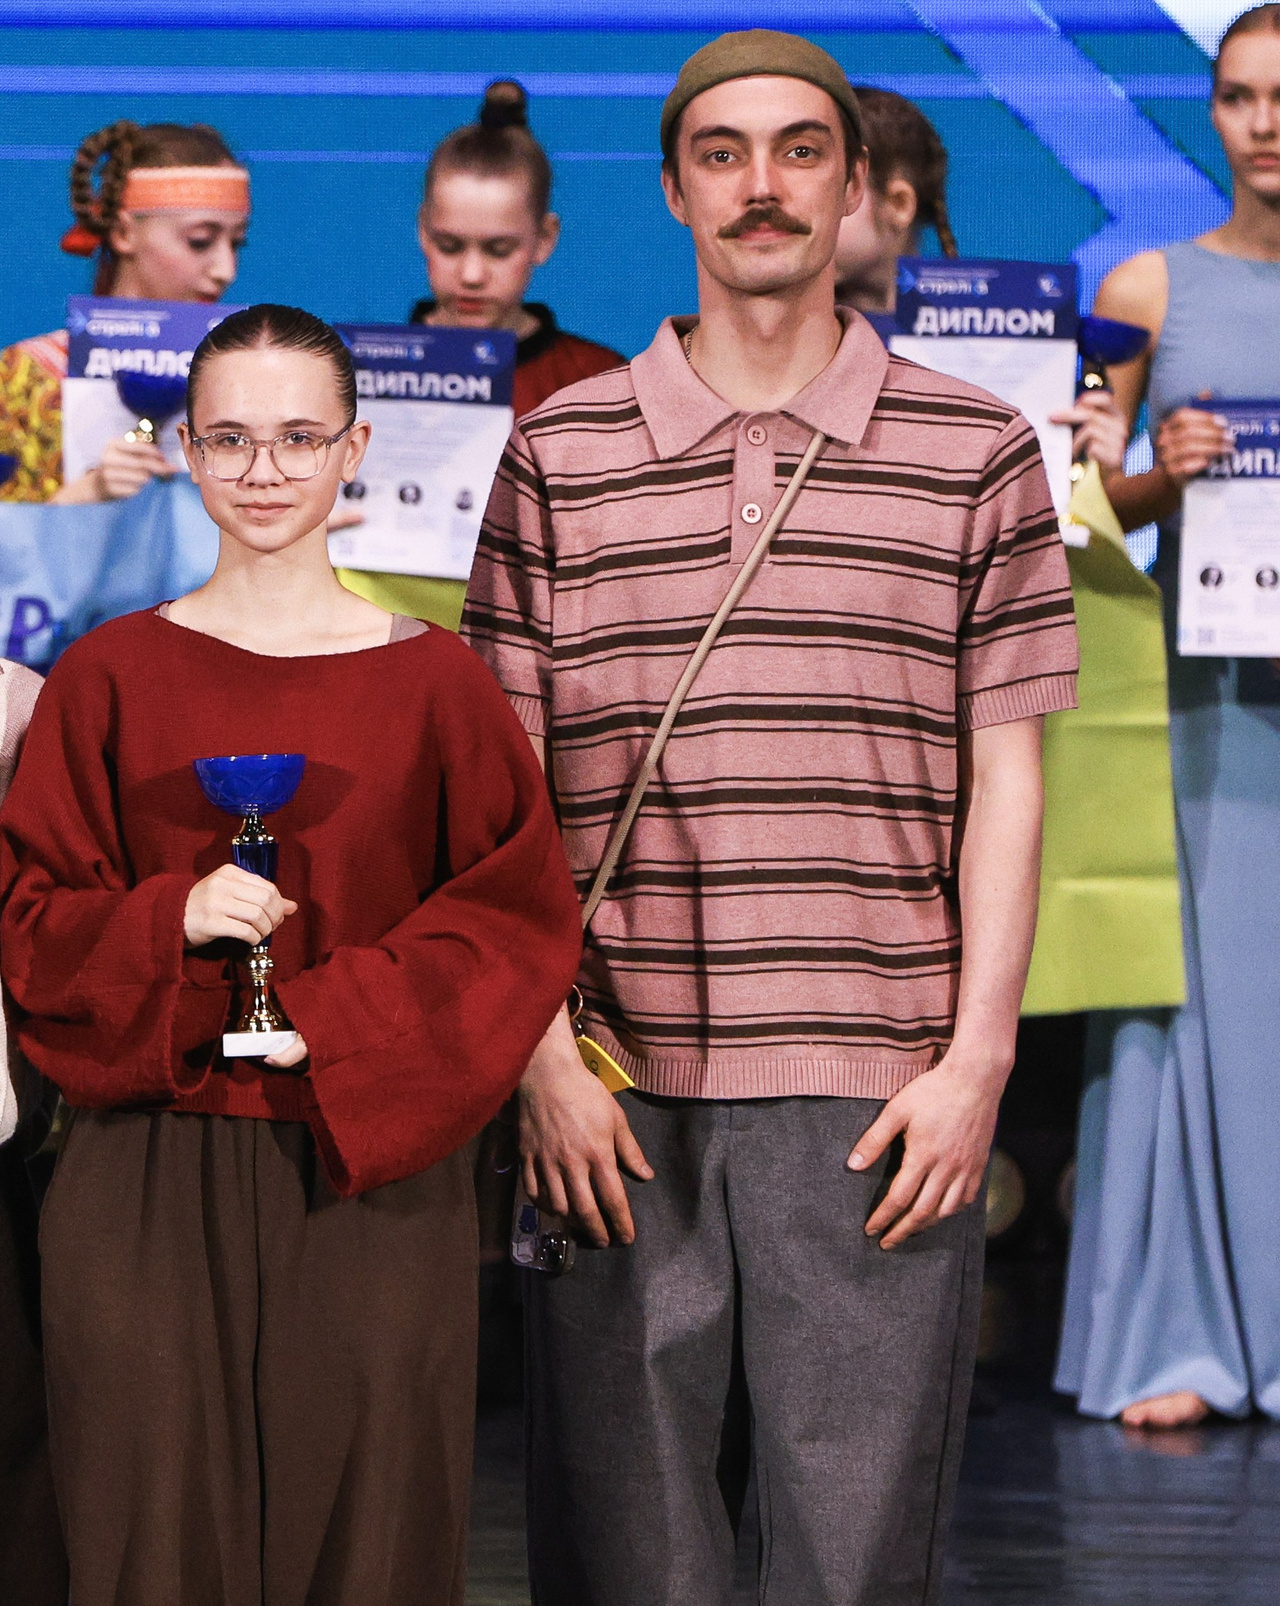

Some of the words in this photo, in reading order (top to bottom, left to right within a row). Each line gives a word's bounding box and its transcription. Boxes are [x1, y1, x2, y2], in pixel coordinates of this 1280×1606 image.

[913, 306, 1055, 336] ДИПЛОМ
[84, 348, 192, 378] ДИПЛО
[355, 369, 492, 401] ДИПЛОМ
[1211, 448, 1280, 480] ДИП
